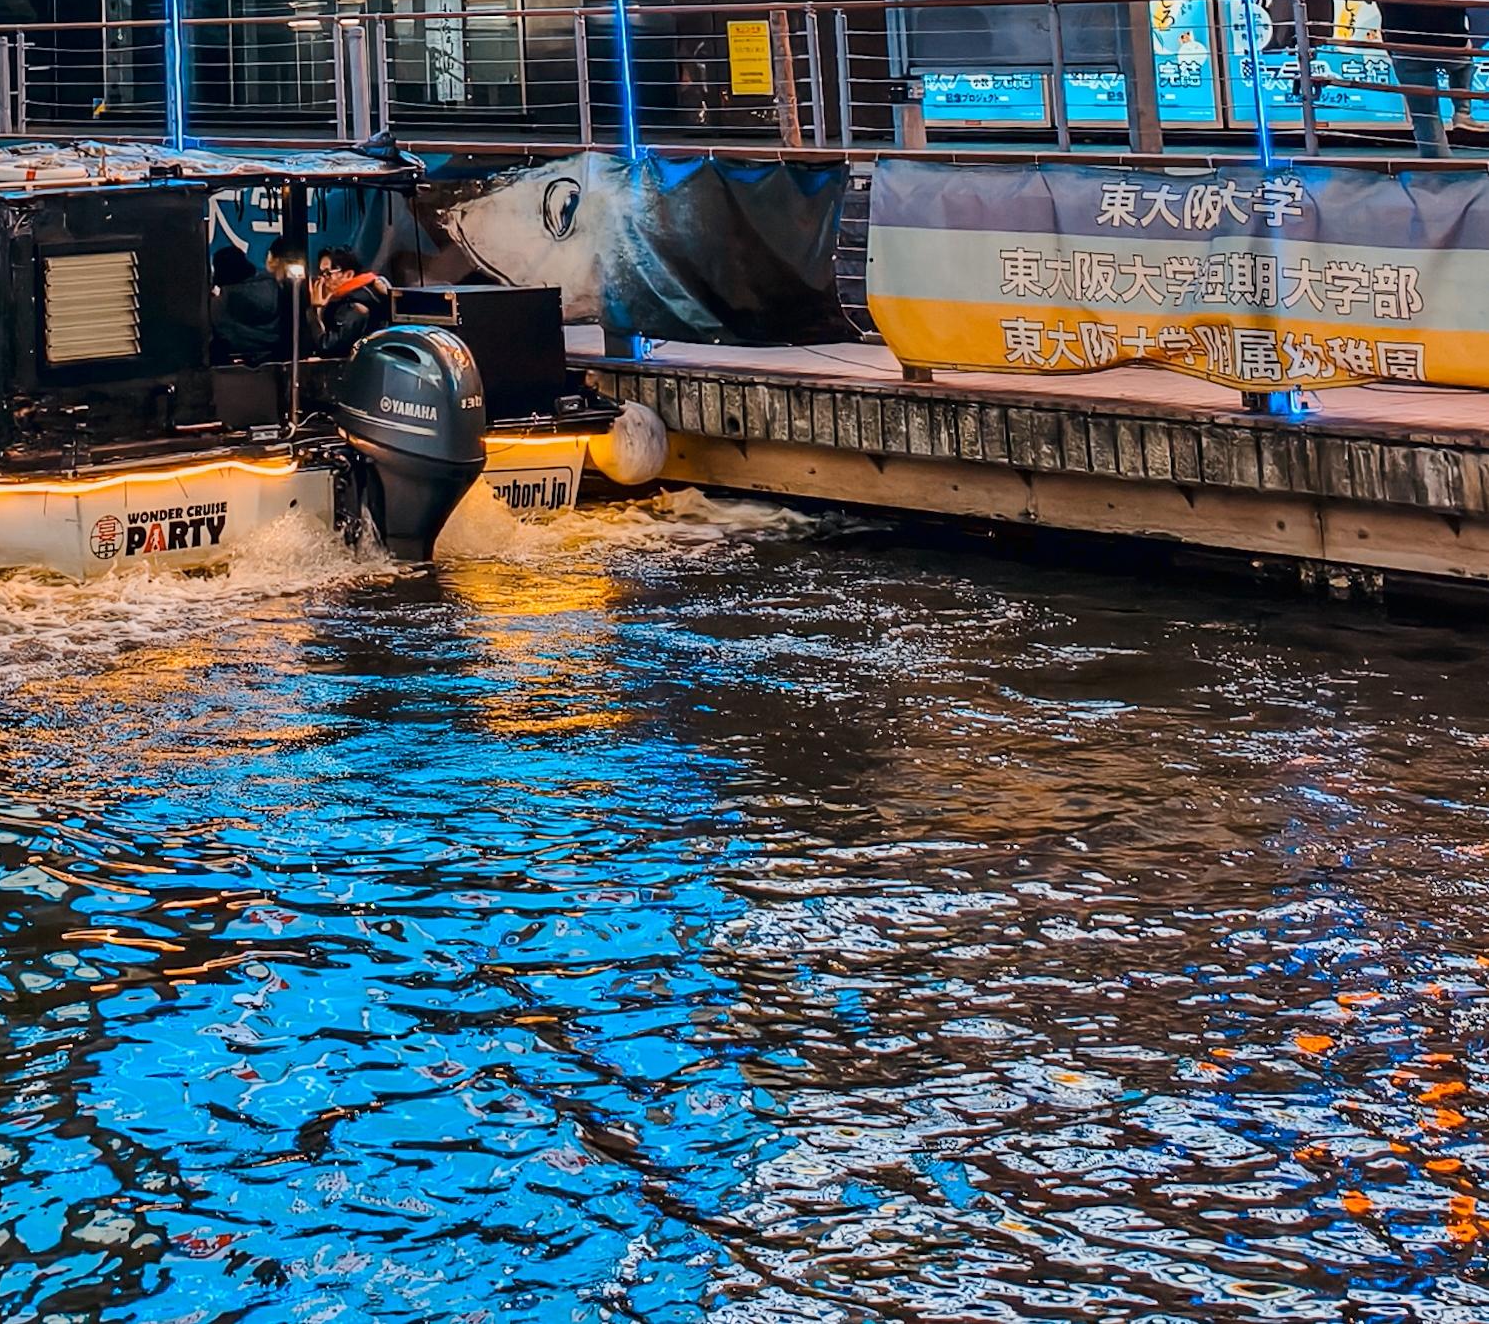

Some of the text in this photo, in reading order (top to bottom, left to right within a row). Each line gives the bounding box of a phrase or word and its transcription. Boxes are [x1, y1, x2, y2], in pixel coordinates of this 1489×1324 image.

[1159, 60, 1202, 88] 完結
[1097, 174, 1305, 230] 東大阪大学
[1000, 247, 1424, 320] 東大阪大学短期大学部
[1000, 317, 1427, 383] 東大阪大学附属幼稚園
[392, 399, 438, 421] YAMAHA
[127, 501, 228, 525] WONDER CRUISE
[125, 515, 226, 556] PARTY
